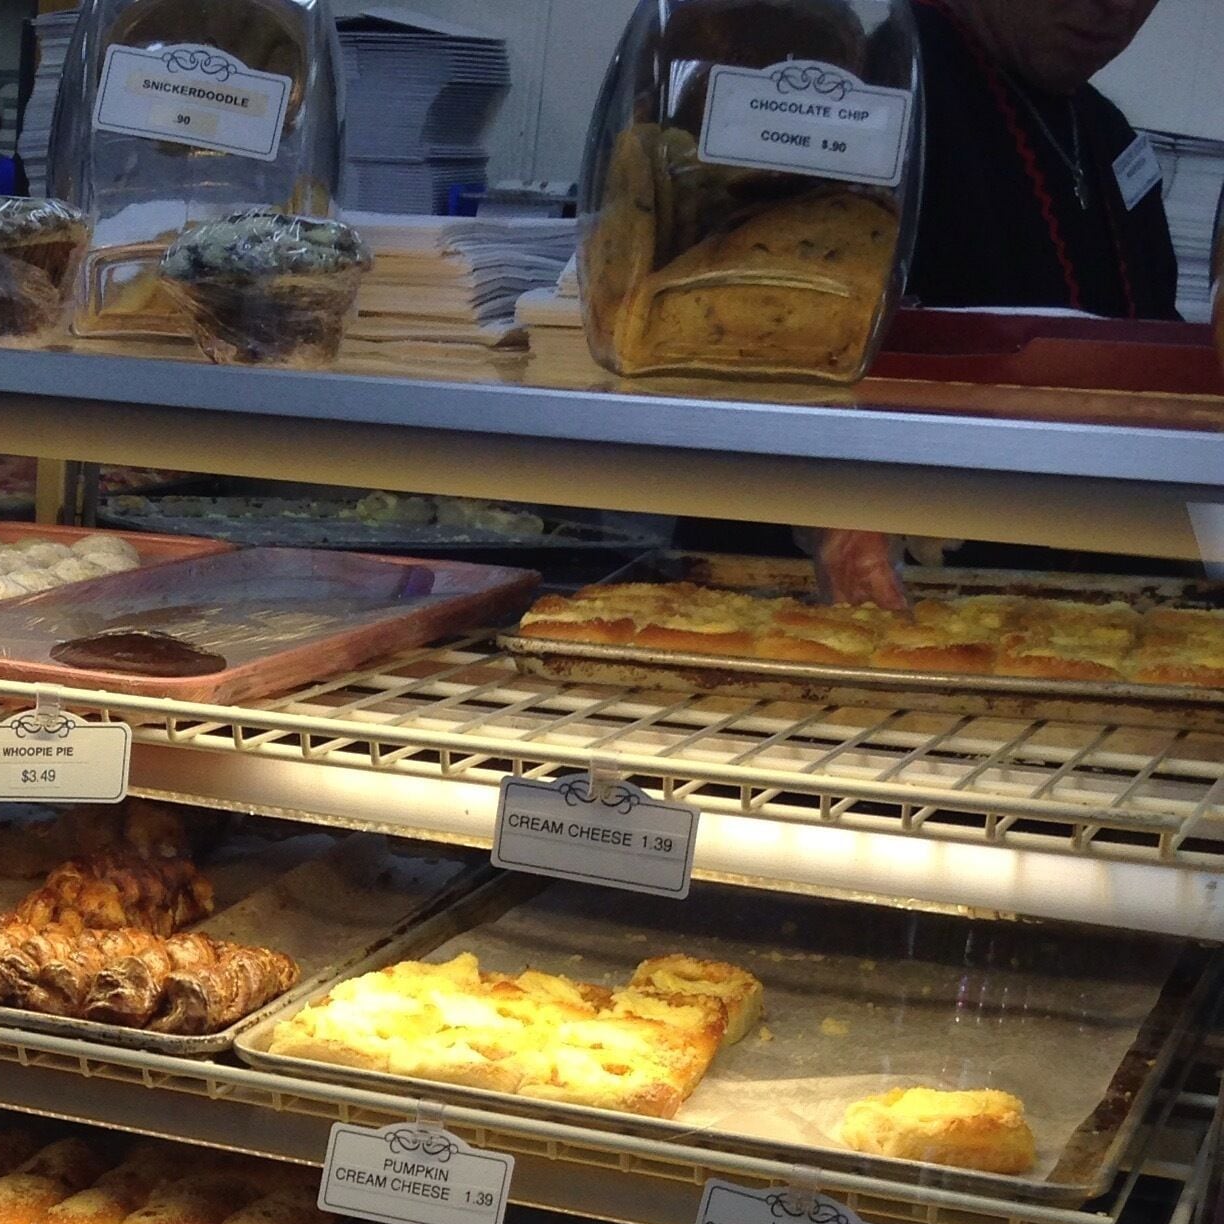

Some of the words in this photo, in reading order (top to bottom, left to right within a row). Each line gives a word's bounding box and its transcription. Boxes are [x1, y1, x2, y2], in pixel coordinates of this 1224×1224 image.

[142, 79, 249, 108] SNICKERDOODLE
[750, 99, 831, 118] CHOCOLATE
[838, 108, 870, 122] CHIP
[760, 130, 811, 147] COOKIE
[2, 747, 53, 757] WHOOPIE
[55, 746, 74, 757] PIE
[21, 769, 56, 783] $3.49
[508, 813, 564, 835] CREAM
[567, 823, 633, 847] CHEESE
[641, 835, 673, 853] 1.39
[383, 1158, 450, 1183] PUMPKIN
[335, 1167, 387, 1188] CREAM
[390, 1177, 451, 1201] CHEESE
[464, 1190, 494, 1207] 1.39
